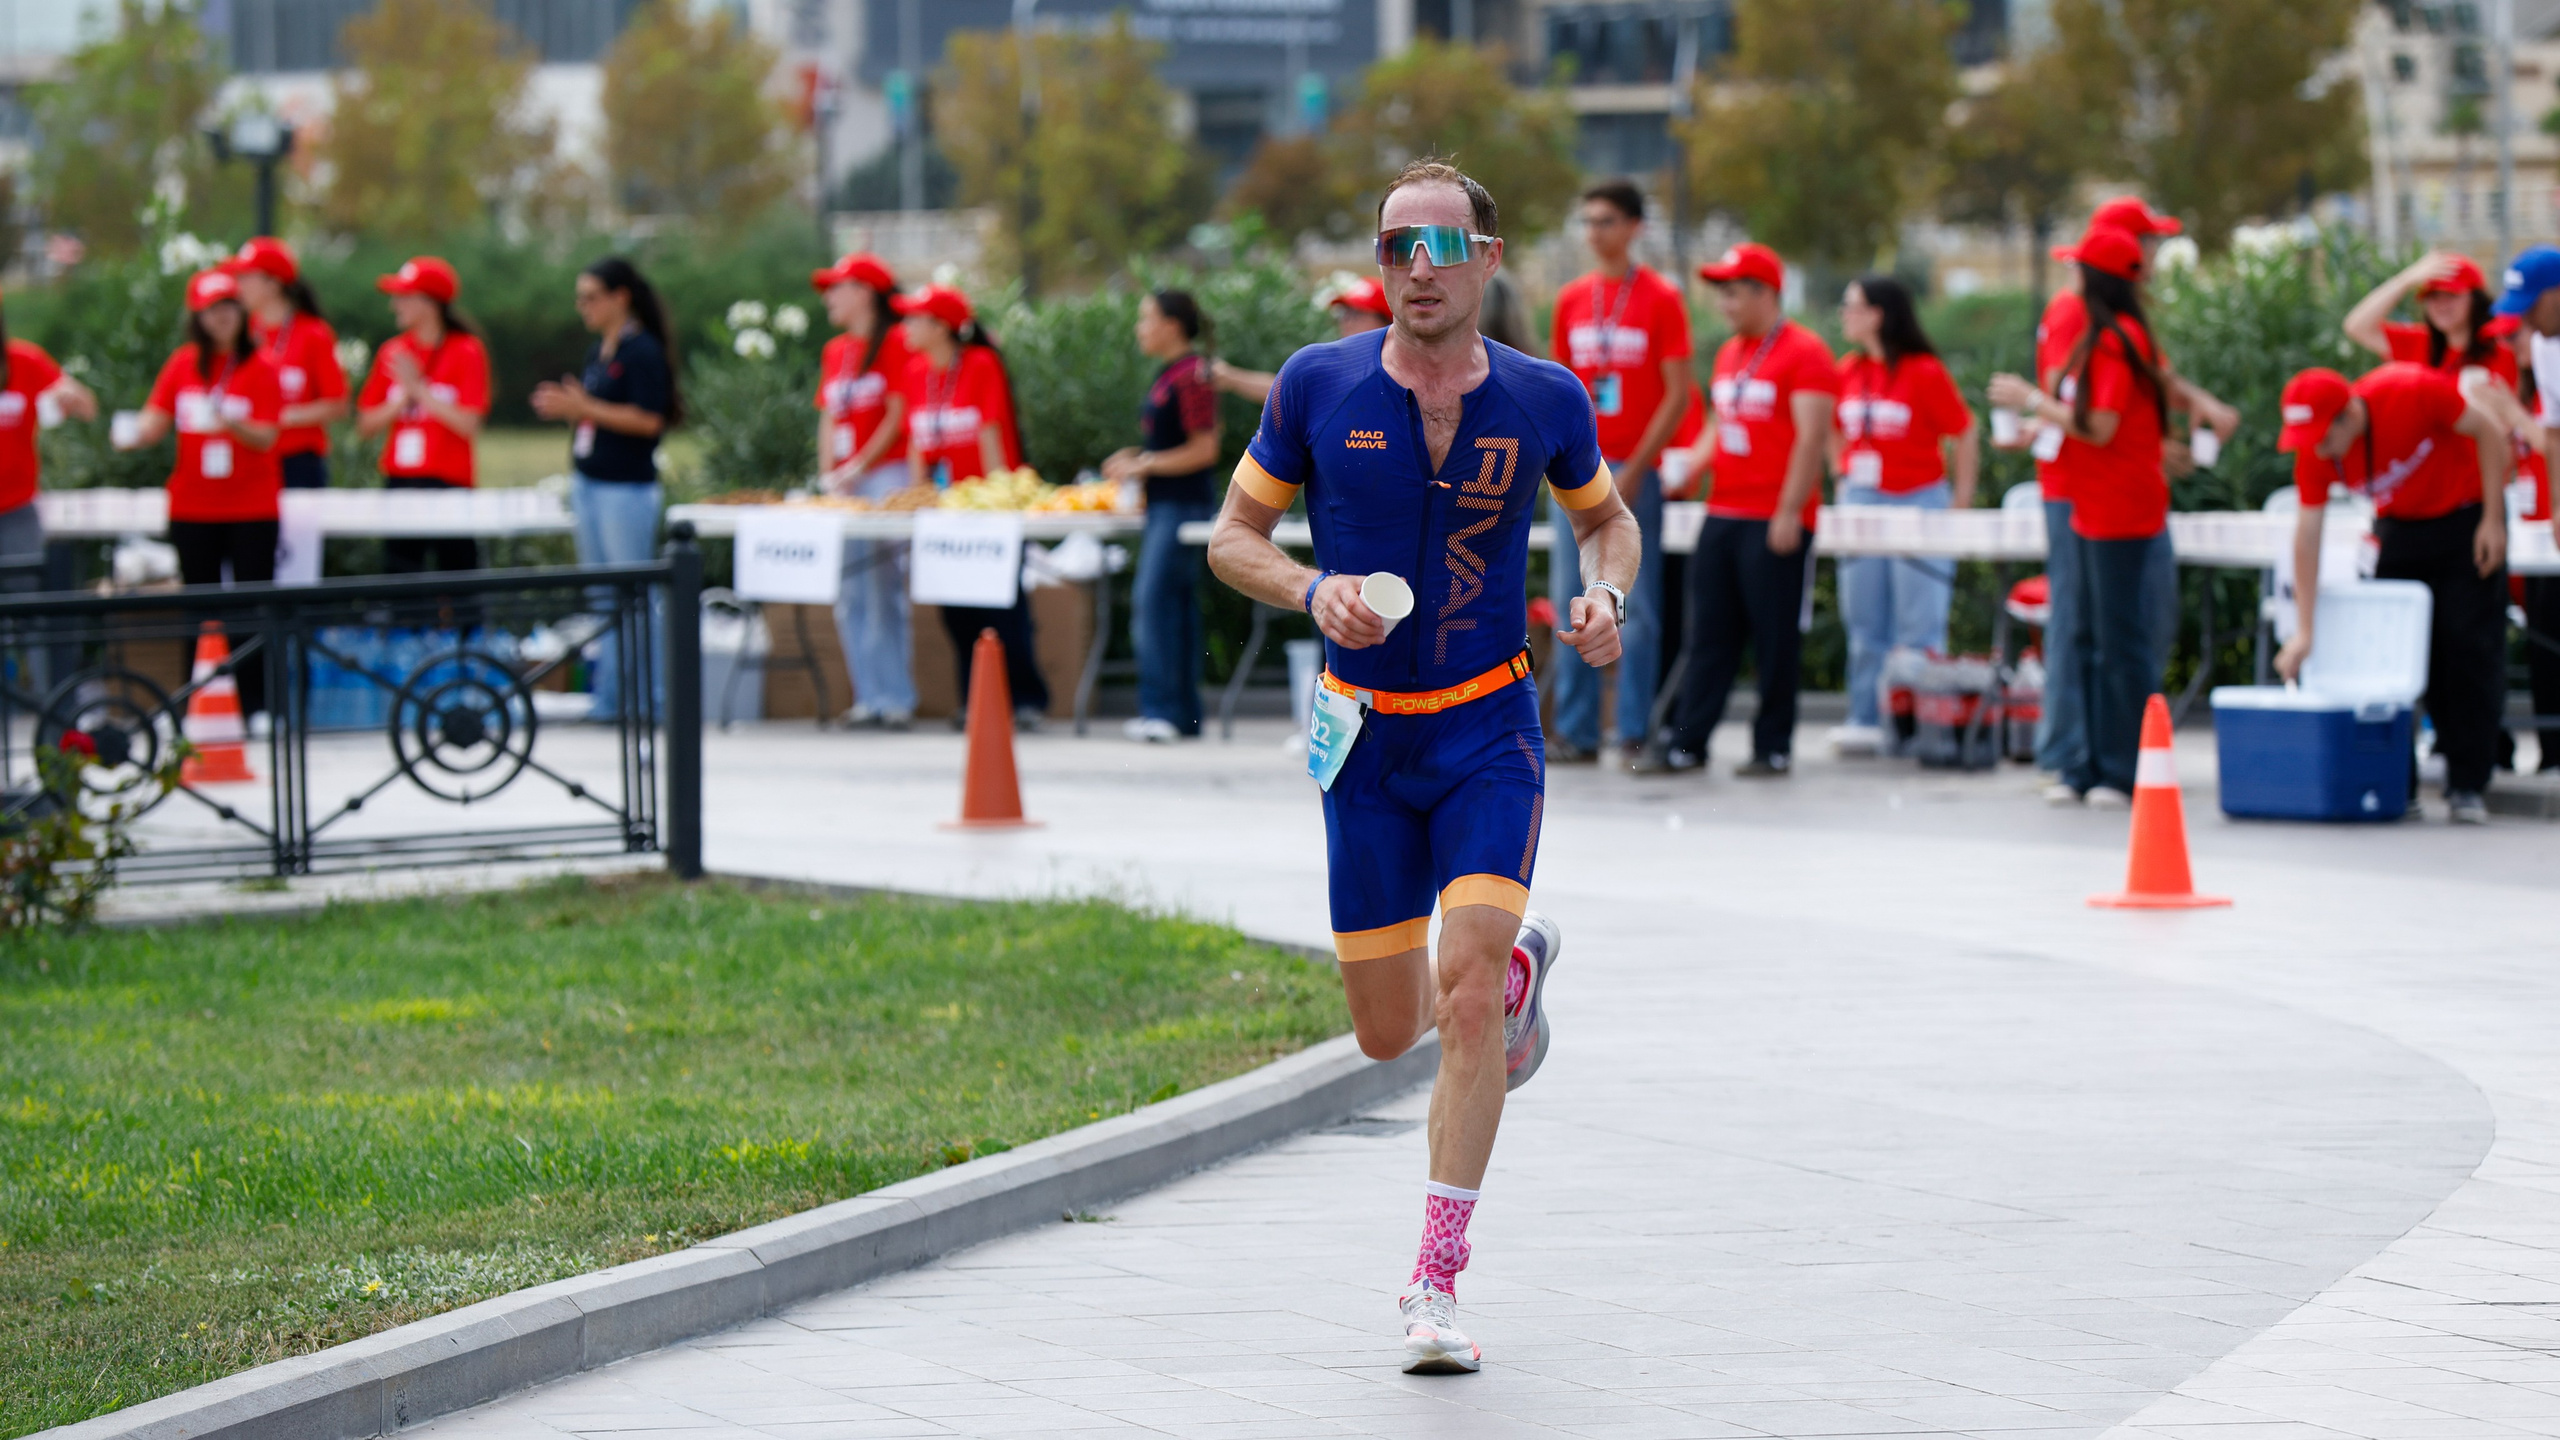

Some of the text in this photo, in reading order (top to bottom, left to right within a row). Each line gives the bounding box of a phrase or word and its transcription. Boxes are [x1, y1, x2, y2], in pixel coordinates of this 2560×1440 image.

[1345, 439, 1387, 449] WAVE
[1350, 429, 1384, 440] MAD
[1434, 437, 1519, 665] RIVAL
[1392, 682, 1479, 711] POWERUP
